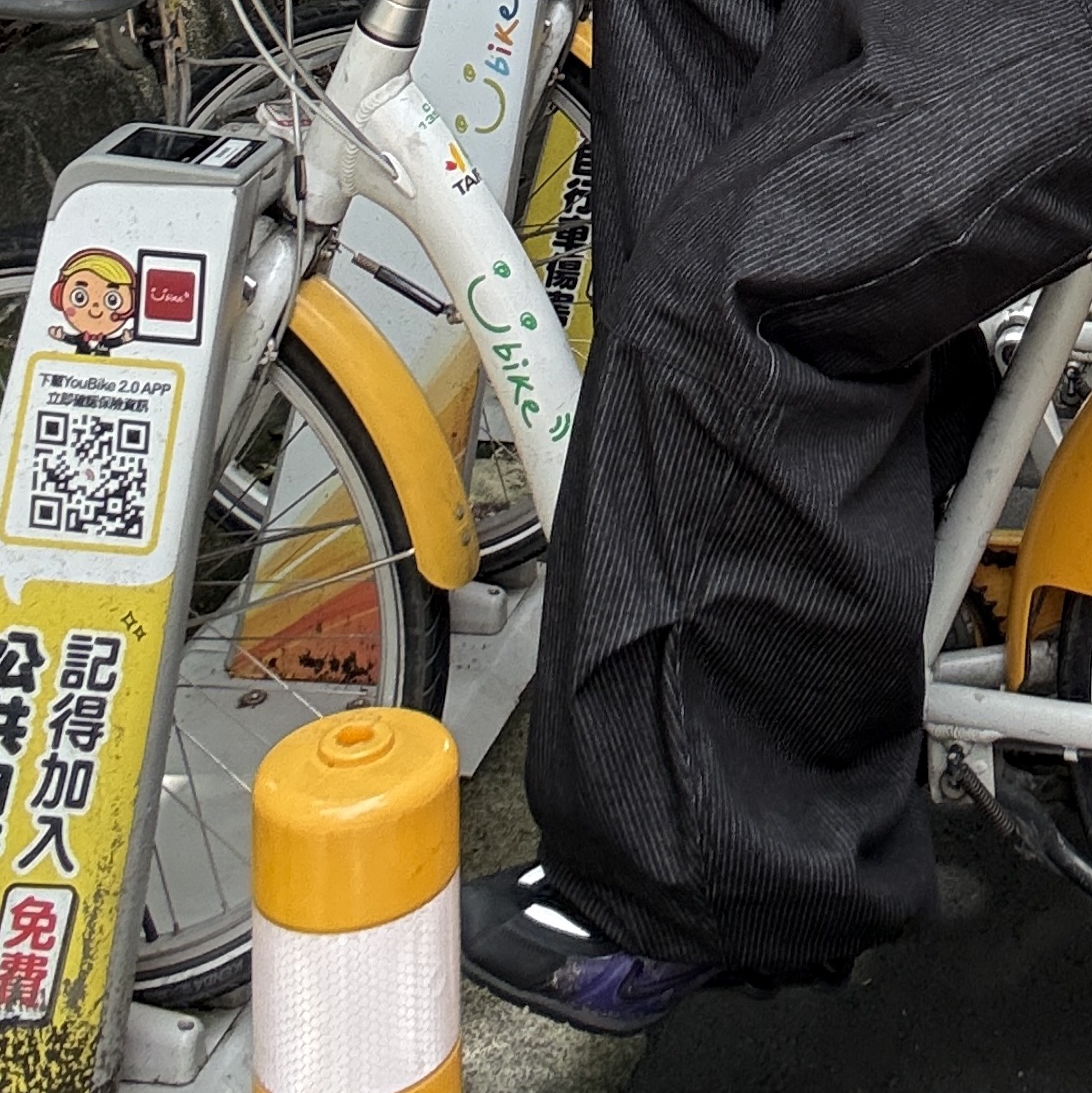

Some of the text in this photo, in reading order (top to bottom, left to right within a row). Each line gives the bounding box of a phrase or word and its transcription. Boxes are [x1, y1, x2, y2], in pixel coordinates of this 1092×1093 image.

[118, 380, 140, 393] 2.0
[141, 382, 171, 396] APP
[17, 633, 121, 873] 記得加入
[0, 895, 57, 1008] 免費
